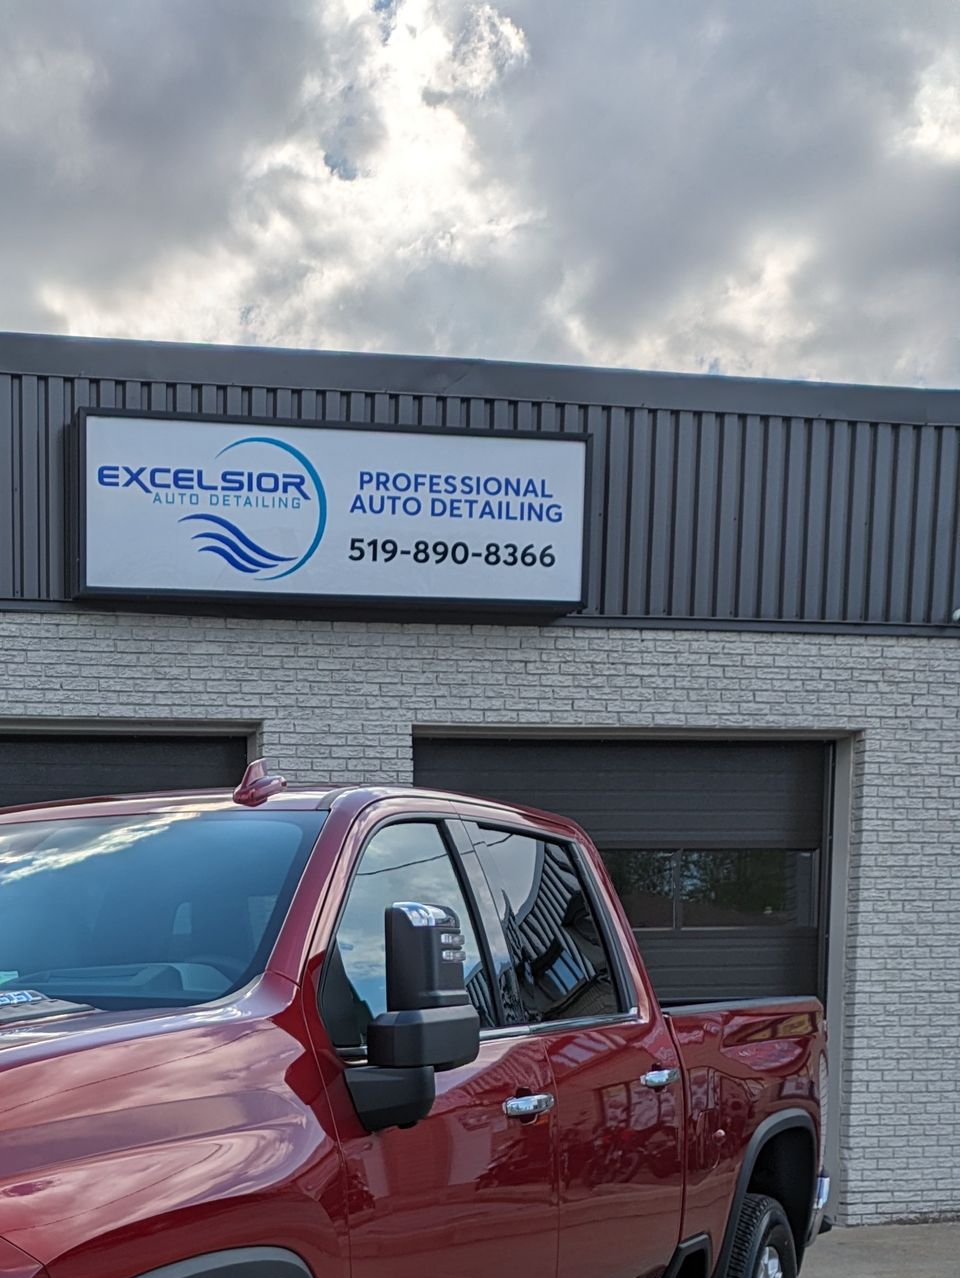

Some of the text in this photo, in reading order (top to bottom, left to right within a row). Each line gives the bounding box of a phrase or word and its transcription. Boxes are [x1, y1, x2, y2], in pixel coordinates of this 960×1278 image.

[97, 465, 311, 500] EXCELSIOR
[359, 471, 554, 498] PROFESSIONAL
[152, 492, 301, 509] AUTO DETAILING
[349, 494, 563, 523] AUTO DETAILING
[348, 538, 556, 568] 519-890-8366
